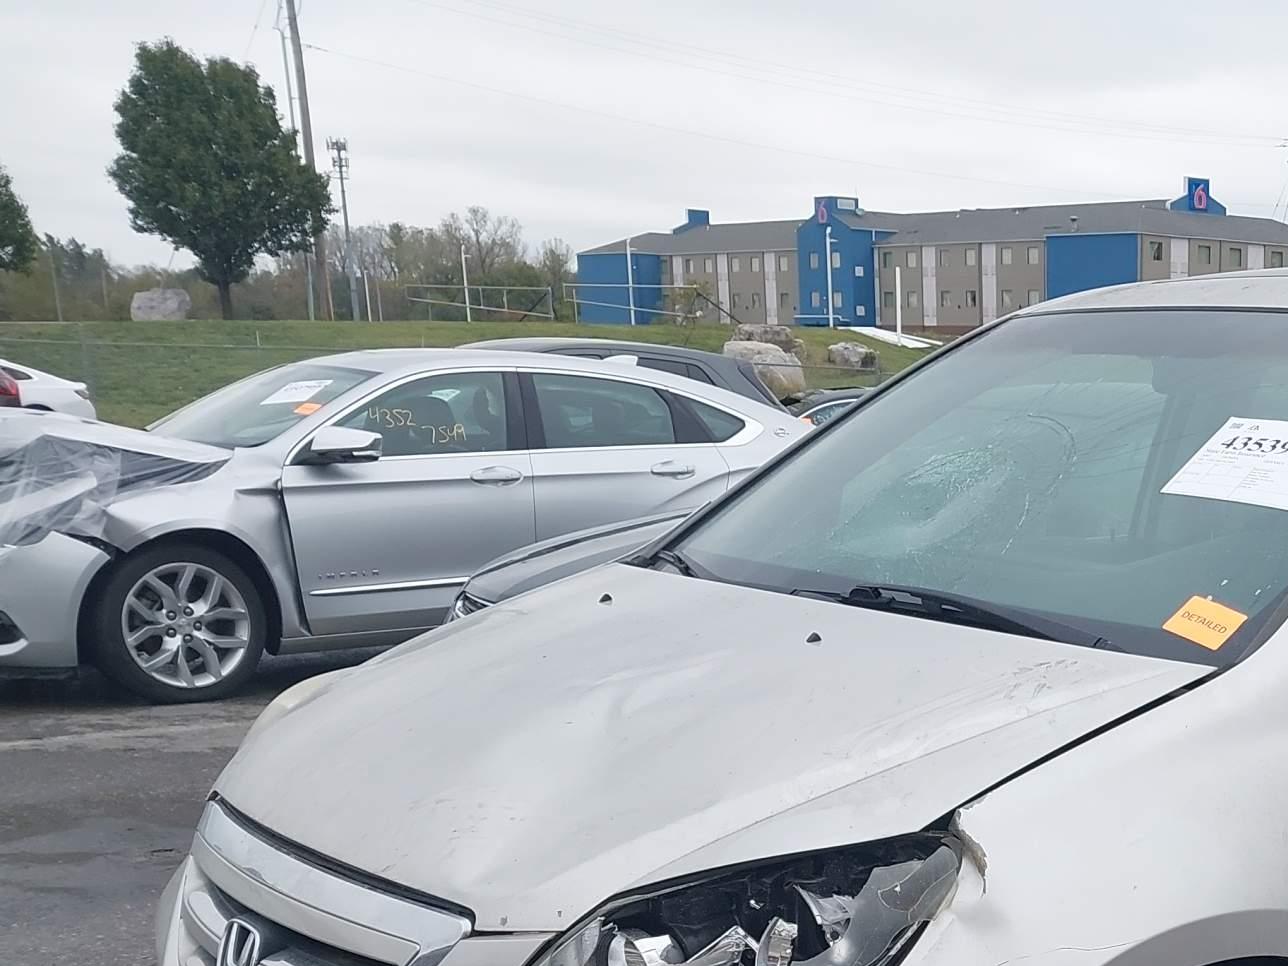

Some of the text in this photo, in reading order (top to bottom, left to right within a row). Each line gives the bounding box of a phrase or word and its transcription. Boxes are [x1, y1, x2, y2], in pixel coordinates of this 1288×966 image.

[368, 406, 416, 428] 4352
[420, 423, 467, 444] 7549
[1181, 610, 1228, 634] DETAILED
